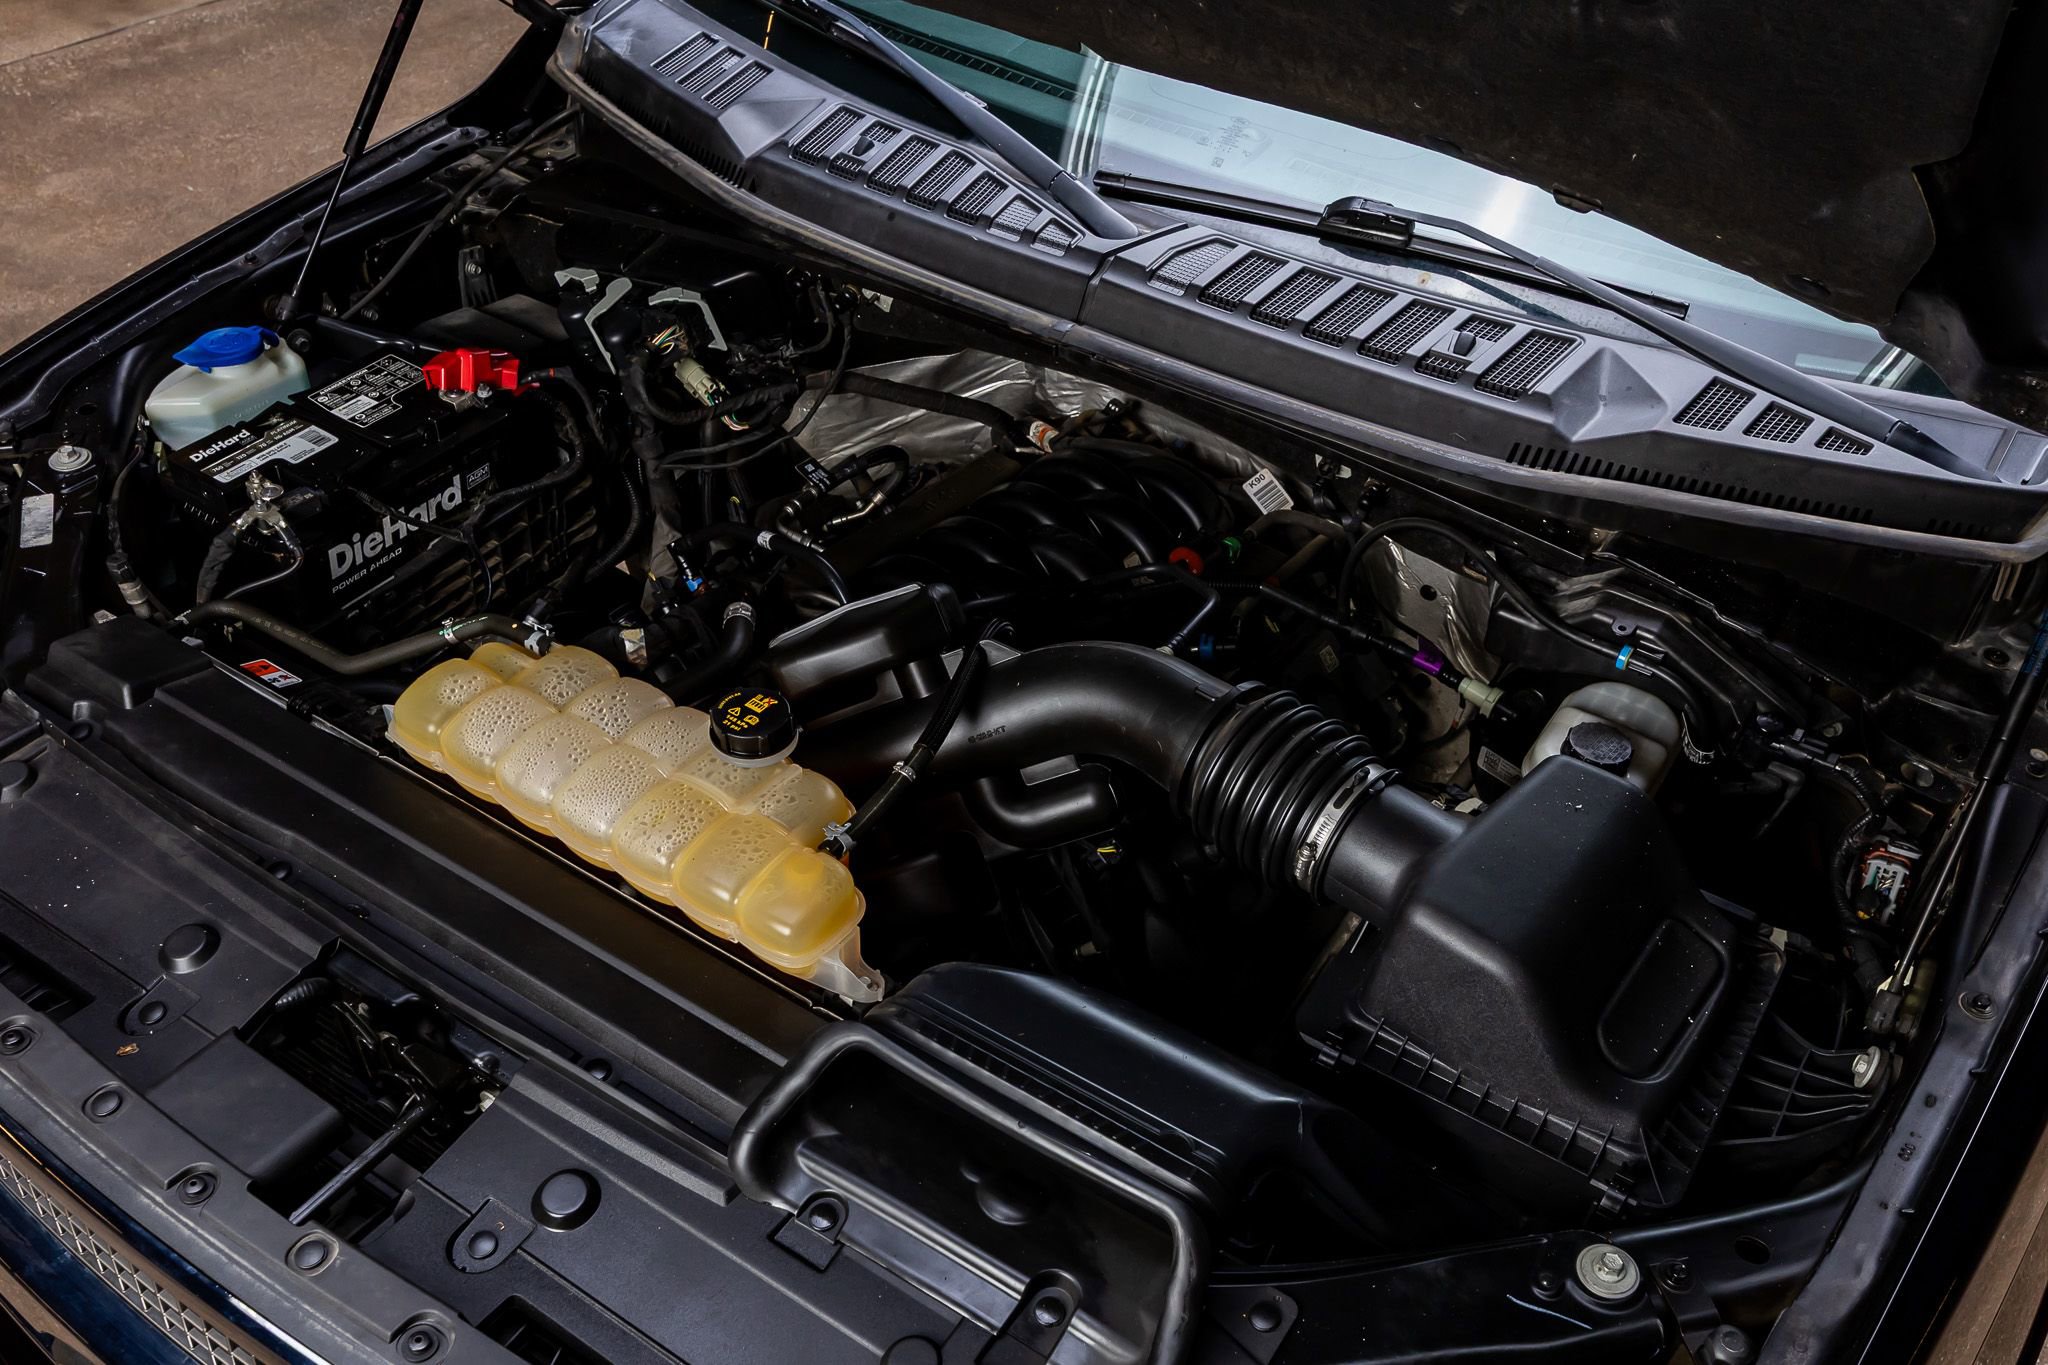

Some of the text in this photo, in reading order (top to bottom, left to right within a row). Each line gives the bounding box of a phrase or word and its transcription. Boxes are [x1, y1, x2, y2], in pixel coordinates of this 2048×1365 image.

[189, 429, 251, 463] DieHard
[469, 465, 489, 482] AGM
[1248, 473, 1266, 489] K90
[327, 473, 463, 580] DieHard
[332, 547, 402, 594] POWER AHEAD
